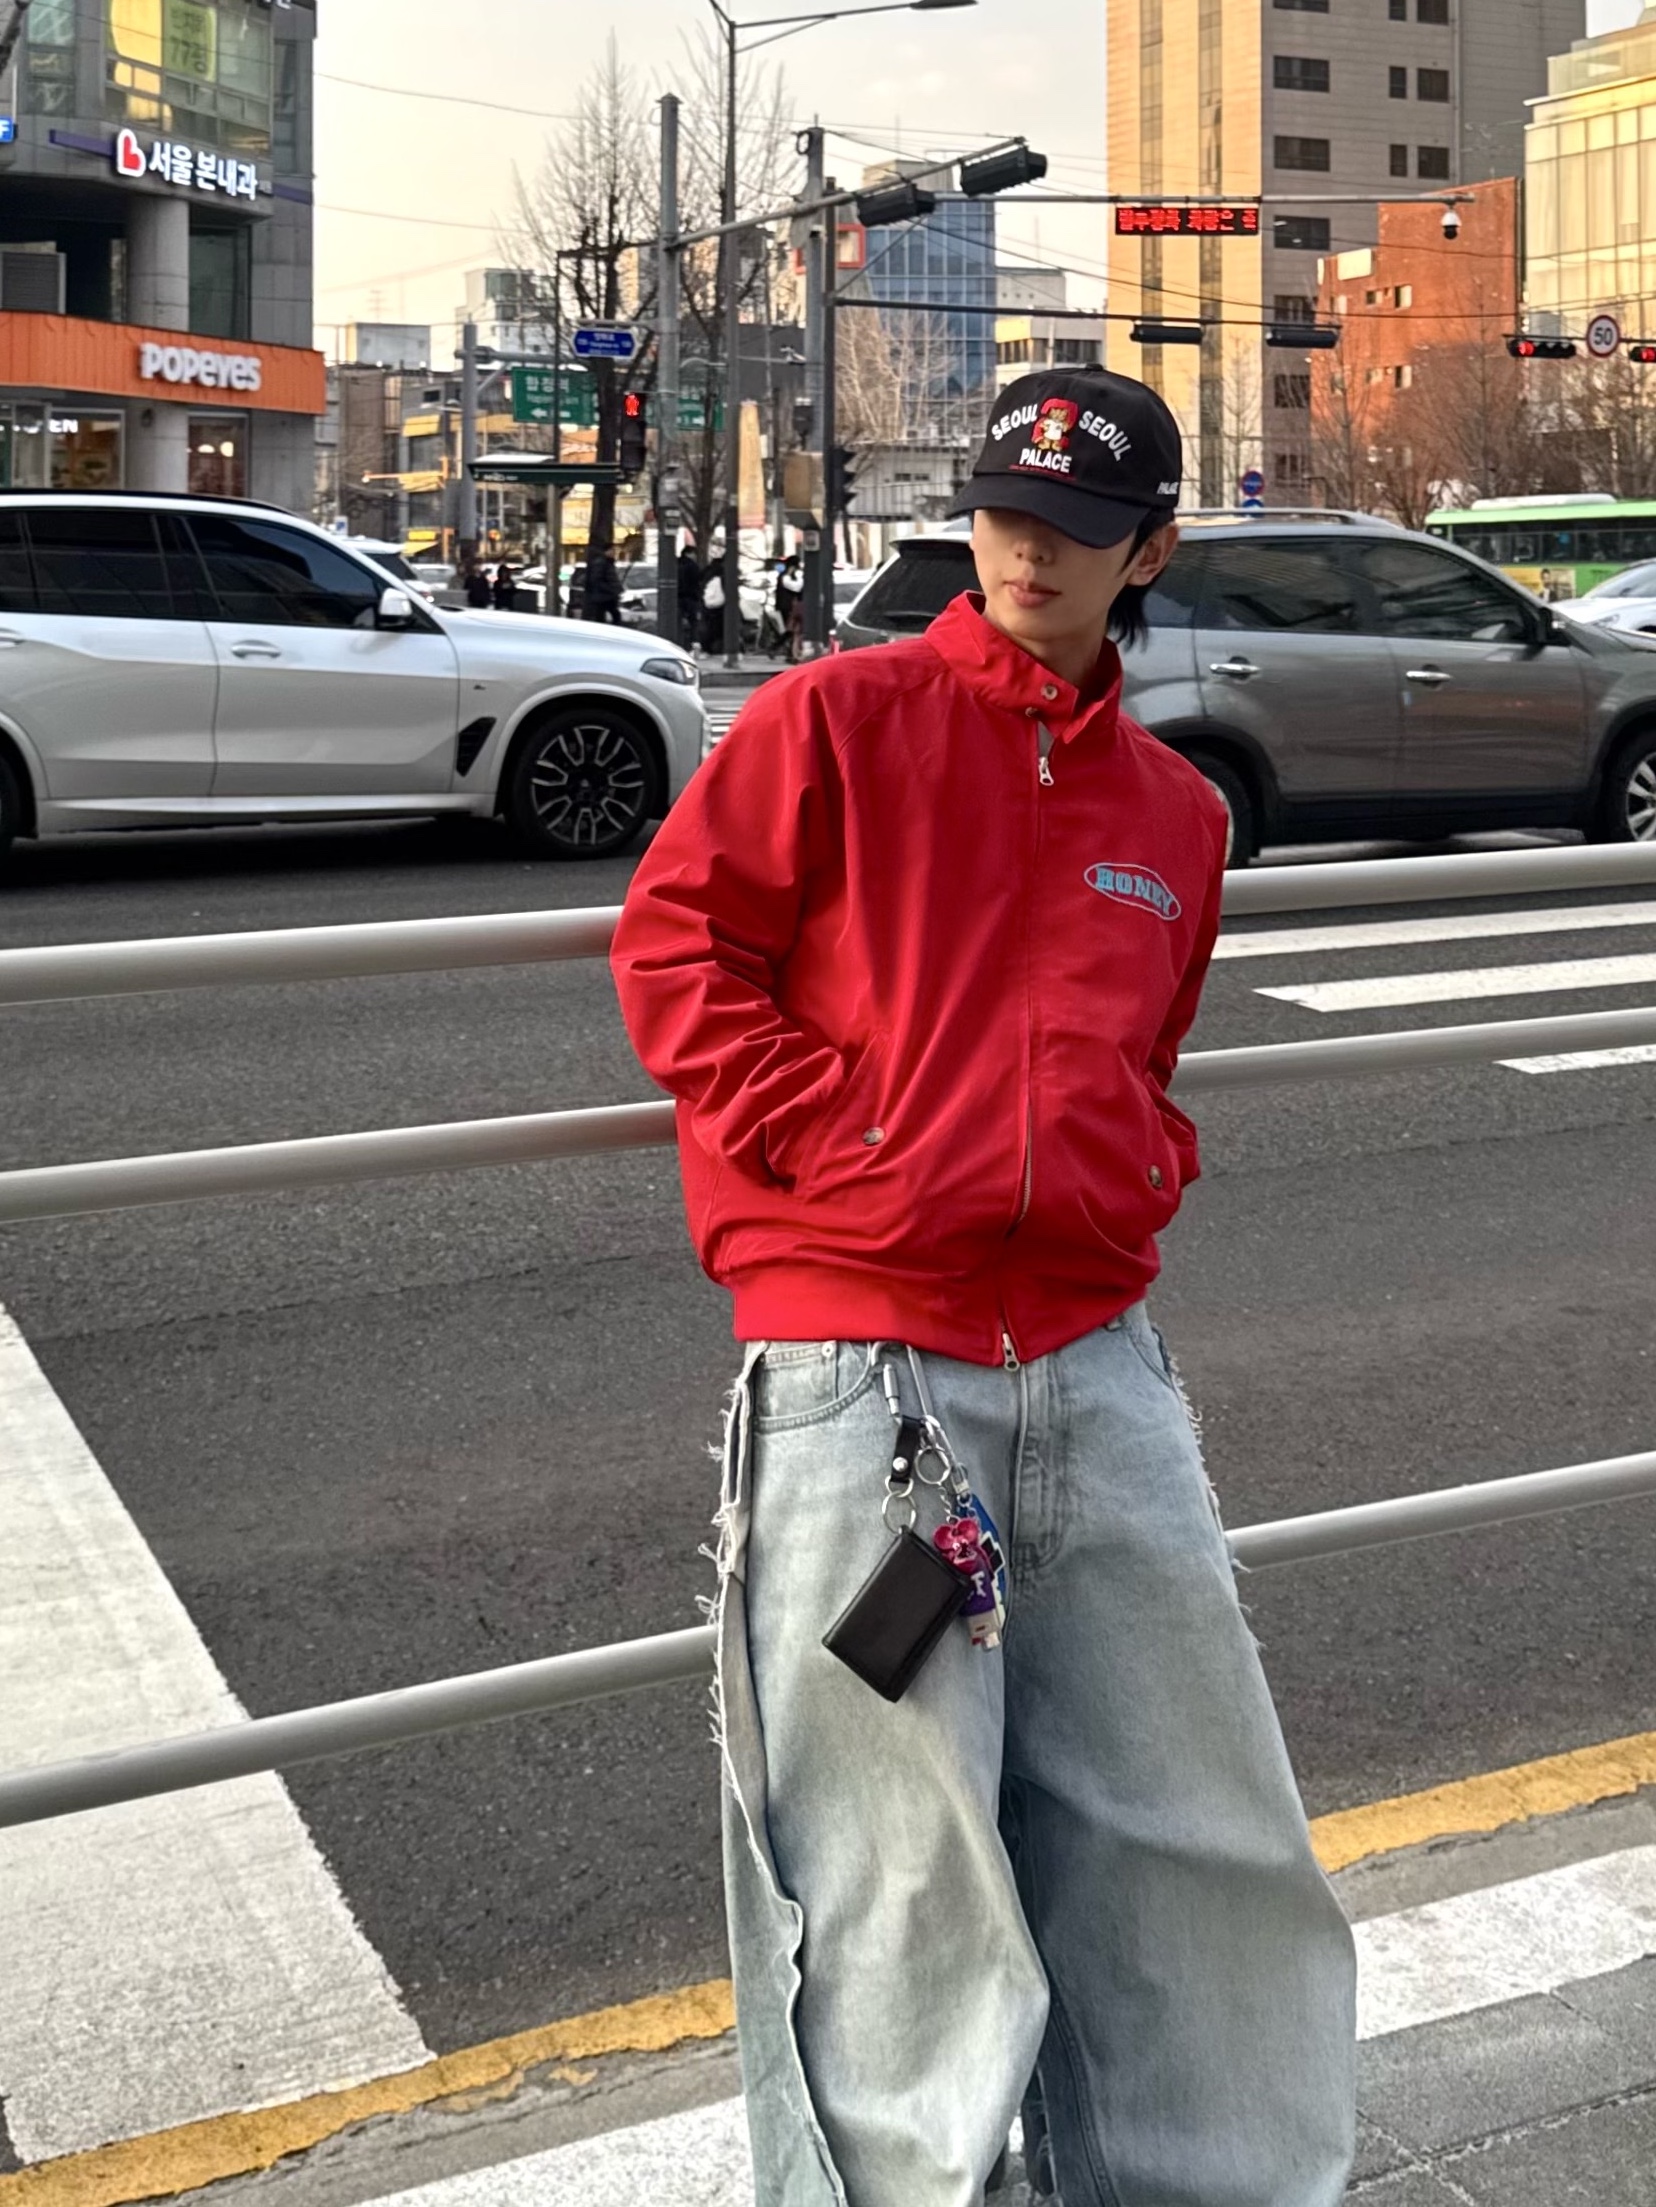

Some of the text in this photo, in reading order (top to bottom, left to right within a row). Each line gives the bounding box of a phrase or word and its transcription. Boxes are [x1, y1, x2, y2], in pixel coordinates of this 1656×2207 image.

[1594, 327, 1613, 346] 50
[991, 403, 1132, 462] SEOUL SEOUL
[1018, 447, 1073, 473] PALACE
